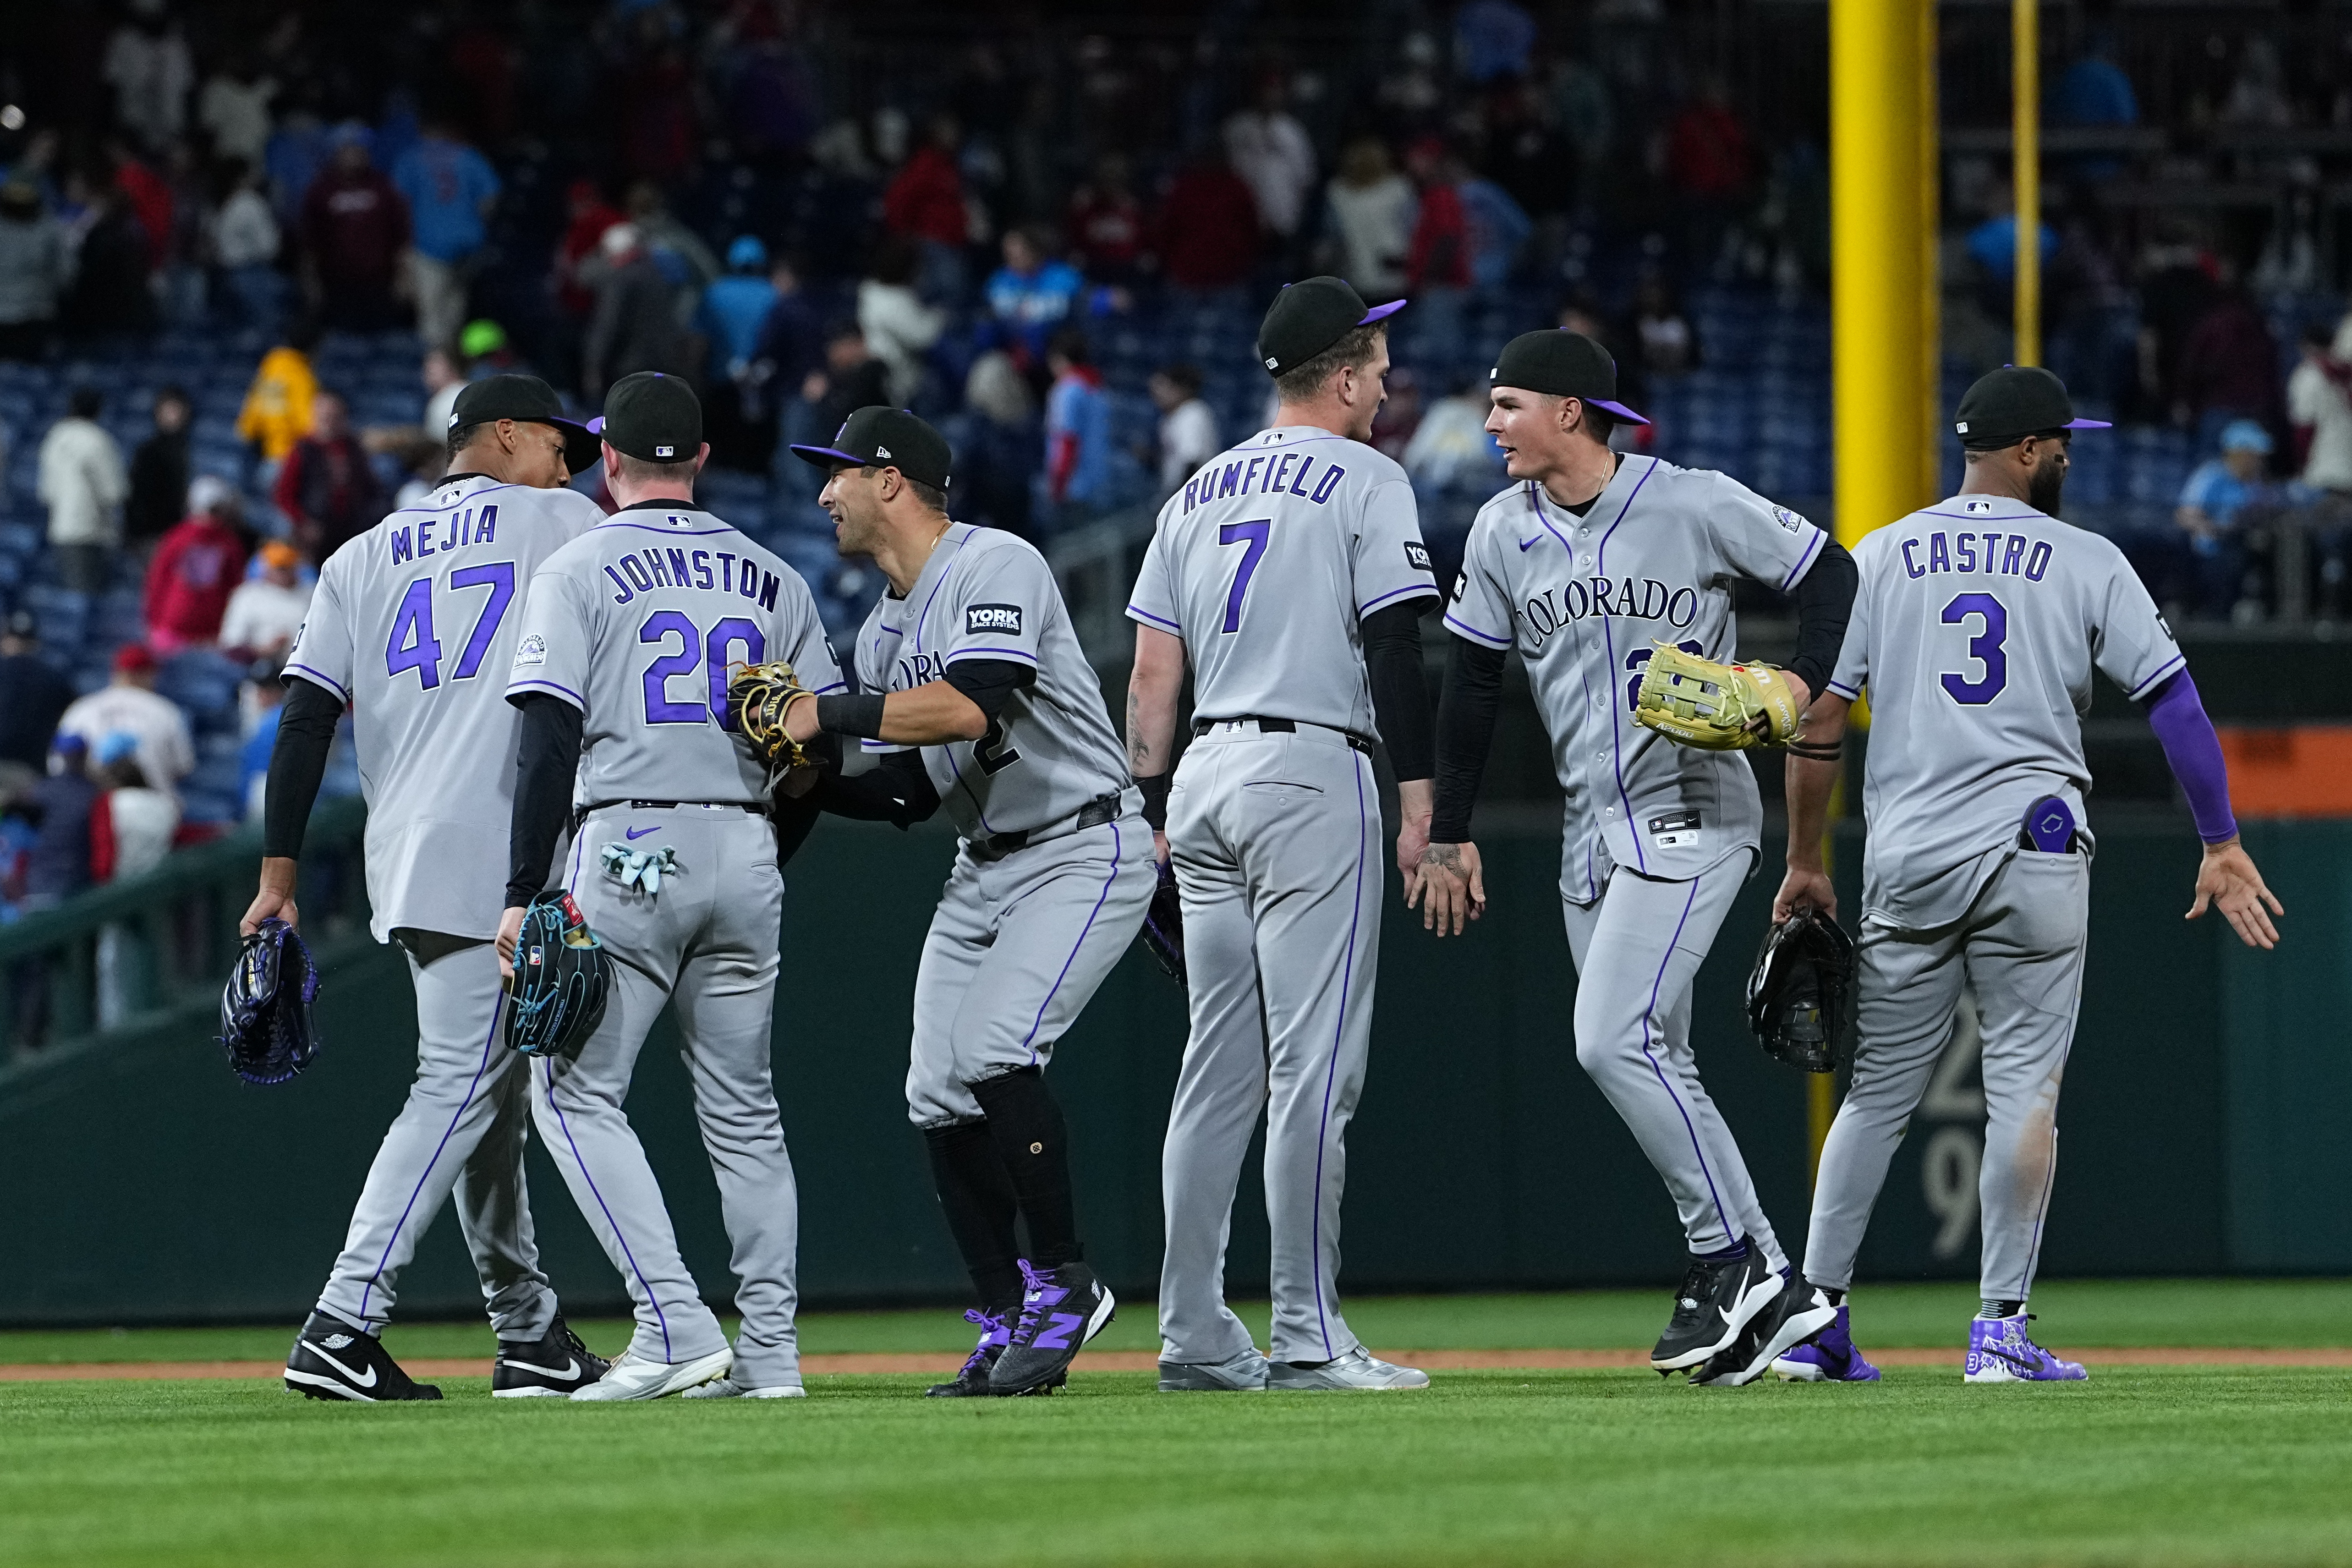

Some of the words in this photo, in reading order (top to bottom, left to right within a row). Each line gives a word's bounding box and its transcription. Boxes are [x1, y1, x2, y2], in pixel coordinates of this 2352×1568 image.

[1183, 452, 1346, 516] RUMFIELD
[391, 505, 500, 568] MEJIA
[1901, 532, 2054, 583] CASTRO
[602, 547, 782, 614] JOHNSTON
[1217, 517, 1273, 635] 7
[385, 559, 516, 693] 47
[968, 609, 1020, 625] YORK
[992, 621, 1020, 630] SYSTEMS
[1516, 576, 1699, 649] COLORADO
[638, 609, 766, 734] 20
[1939, 591, 2008, 707] 3
[1656, 722, 1694, 739] A2000
